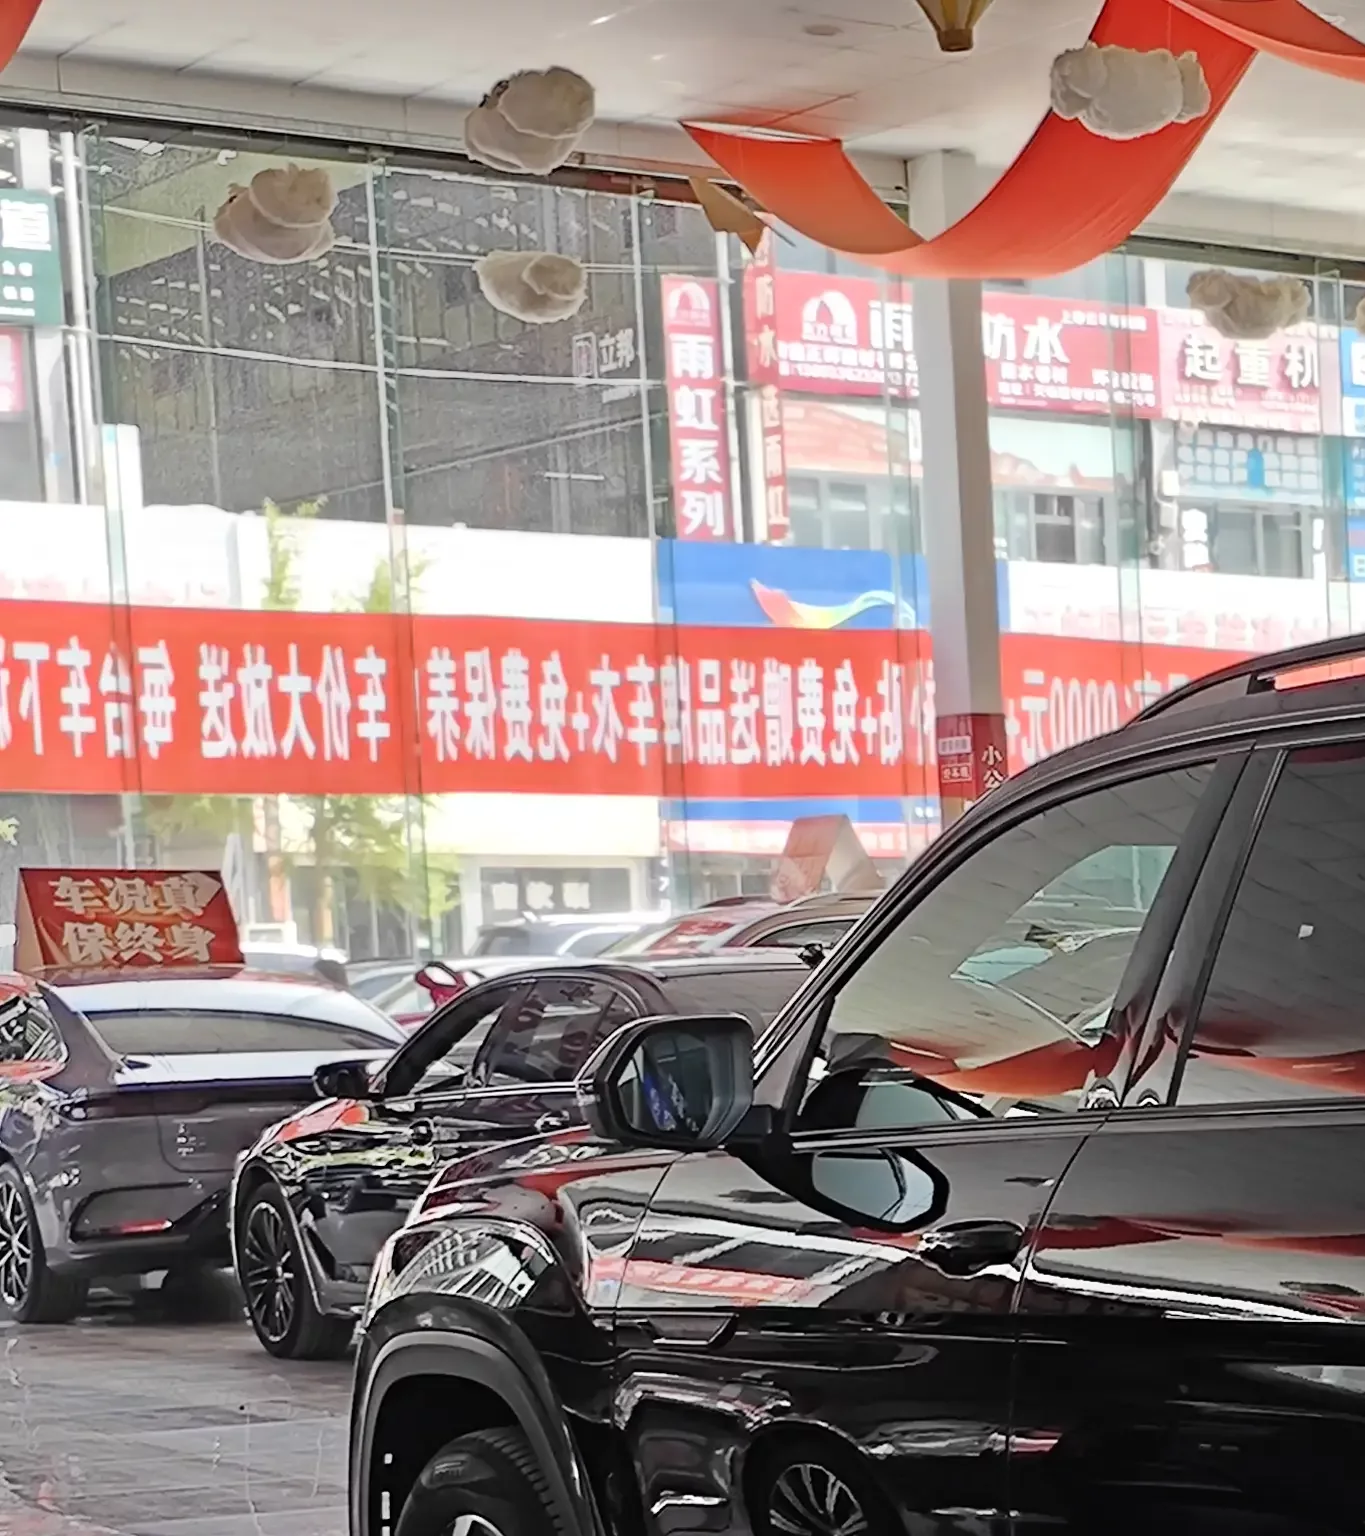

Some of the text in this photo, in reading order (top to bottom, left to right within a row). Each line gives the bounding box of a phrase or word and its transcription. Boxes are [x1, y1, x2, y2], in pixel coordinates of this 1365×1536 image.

[668, 334, 726, 537] 雨虹系列
[52, 874, 207, 916] 车况真
[61, 921, 214, 964] 保终身
